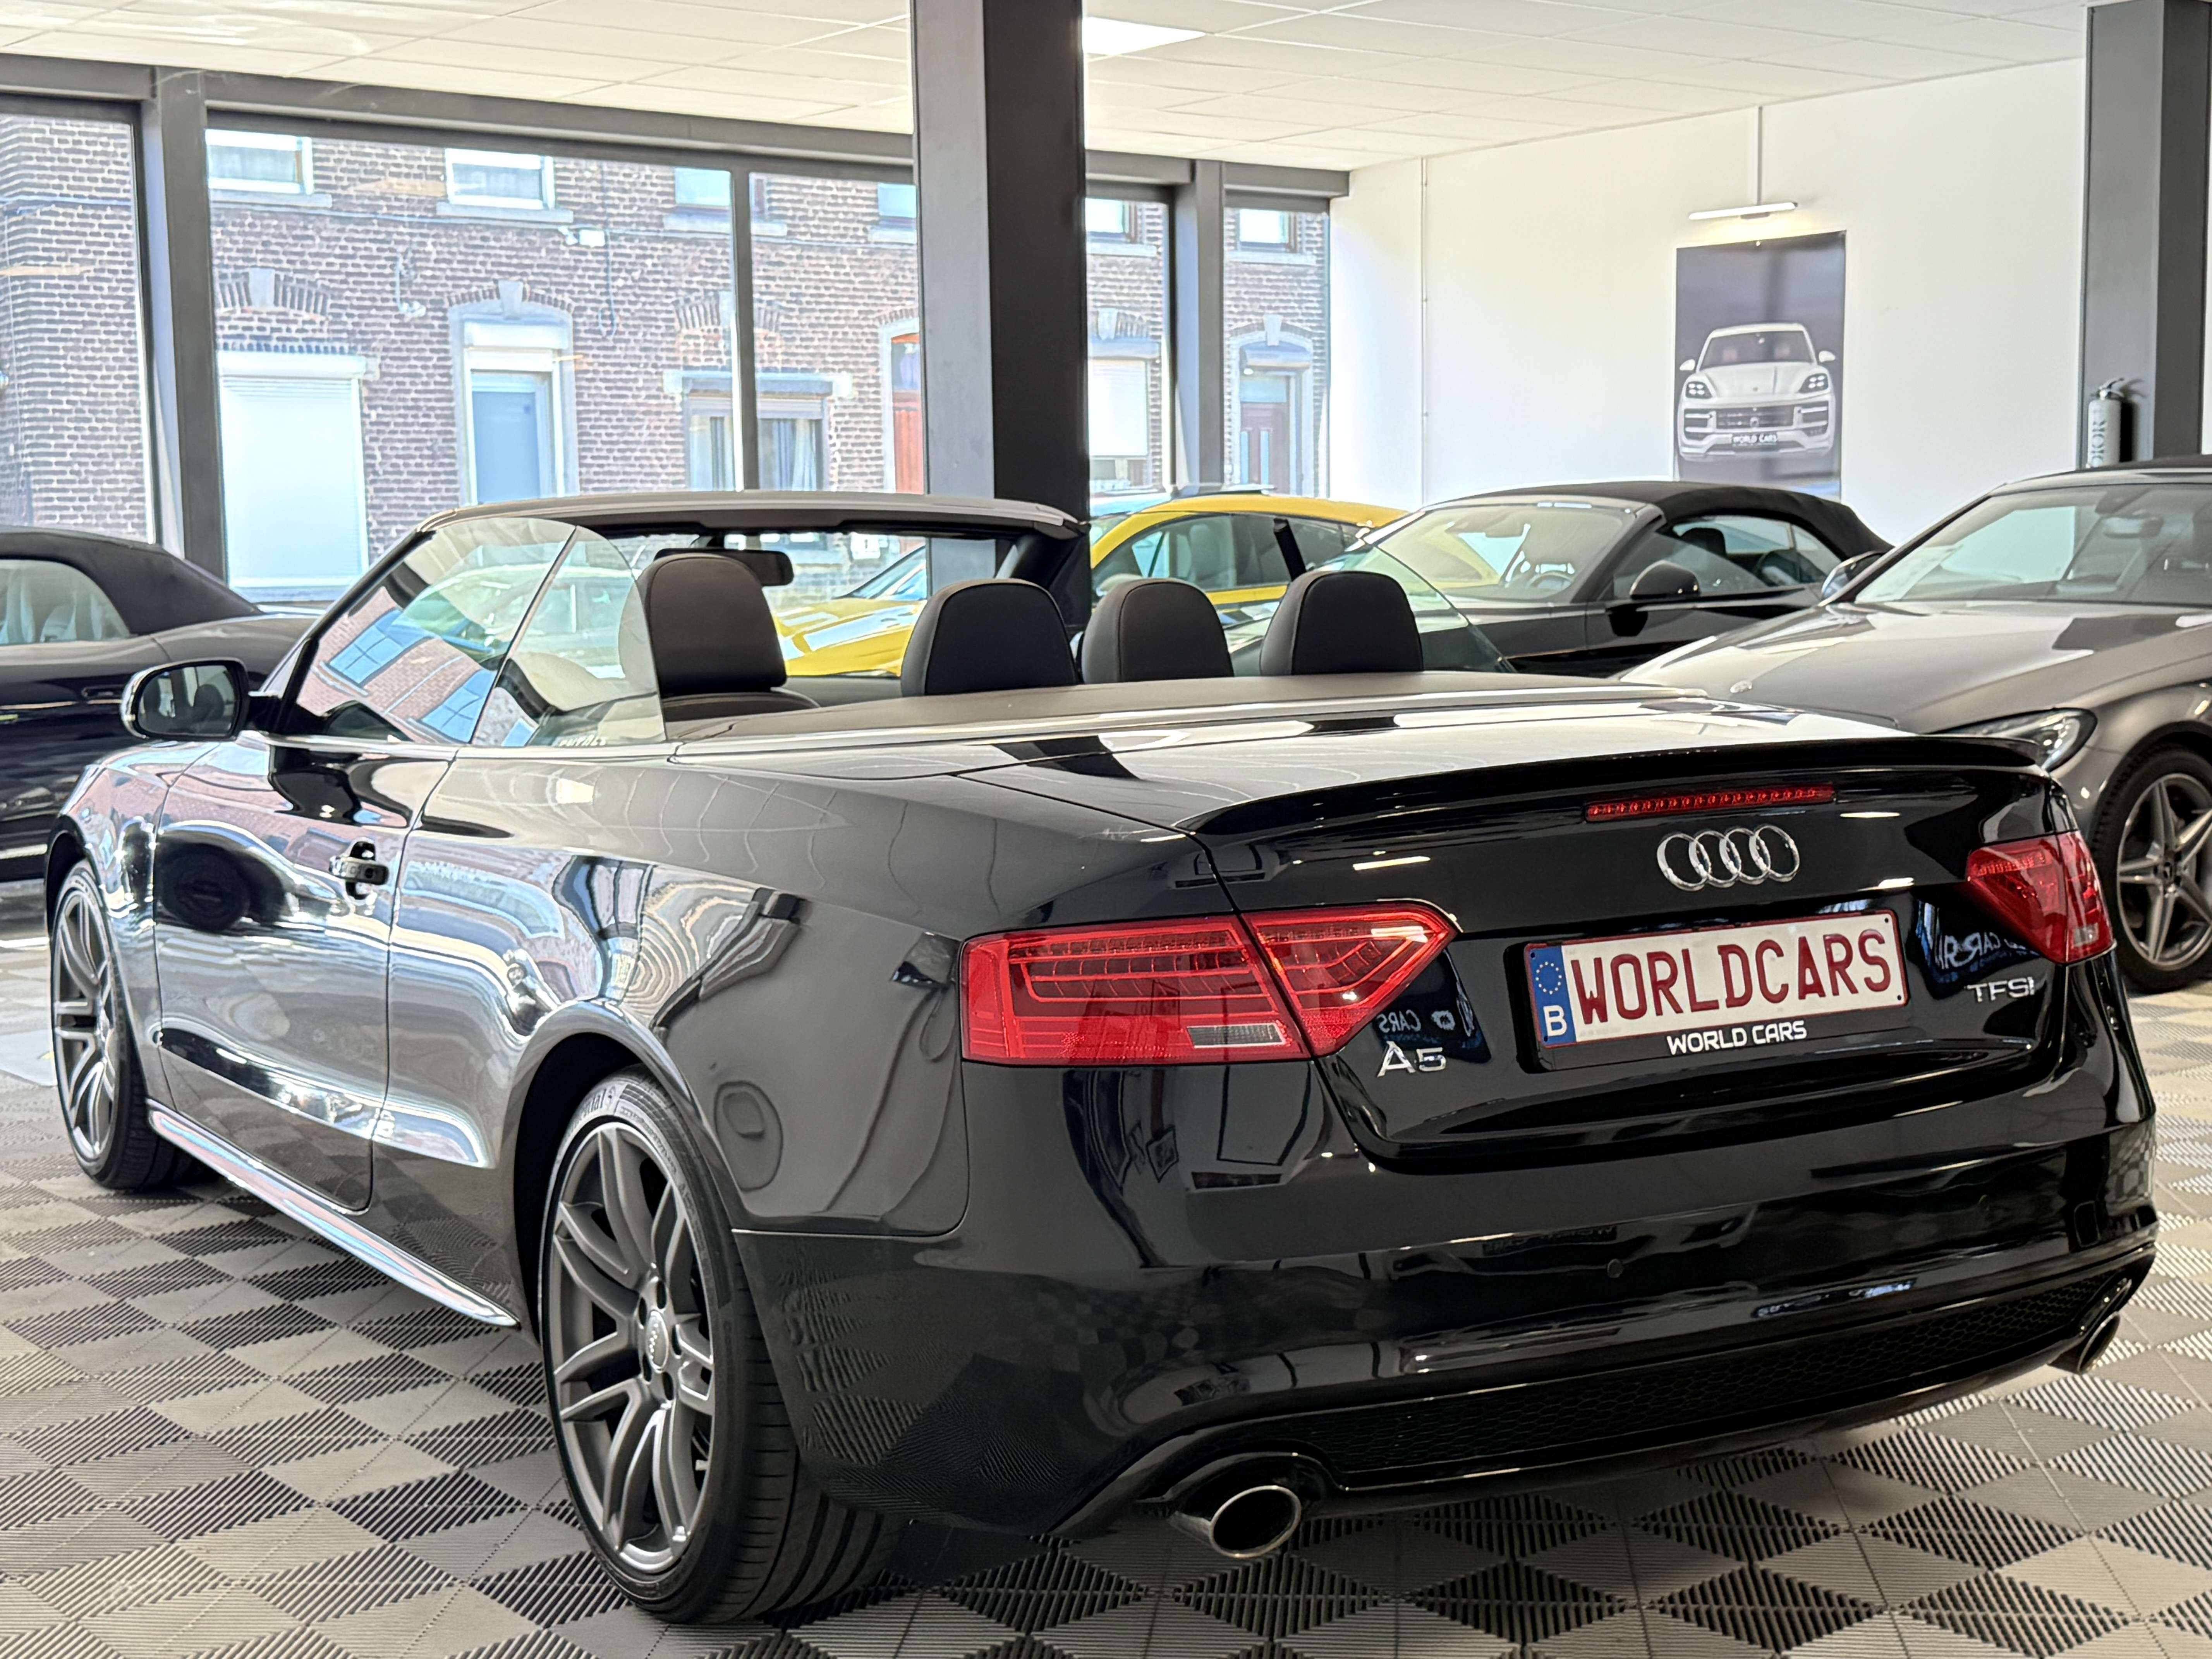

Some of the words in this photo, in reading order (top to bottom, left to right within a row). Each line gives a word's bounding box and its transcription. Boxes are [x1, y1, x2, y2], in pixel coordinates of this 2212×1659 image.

[1733, 434, 1757, 443] WORLD
[1759, 433, 1777, 443] CARS
[1570, 928, 1891, 1025] WORLDCARS
[1965, 976, 2035, 1003] TFSI
[1543, 1005, 1568, 1037] B
[1666, 1029, 1748, 1055] WORLD
[1752, 1020, 1808, 1043] CARS
[1376, 1040, 1447, 1078] A5
